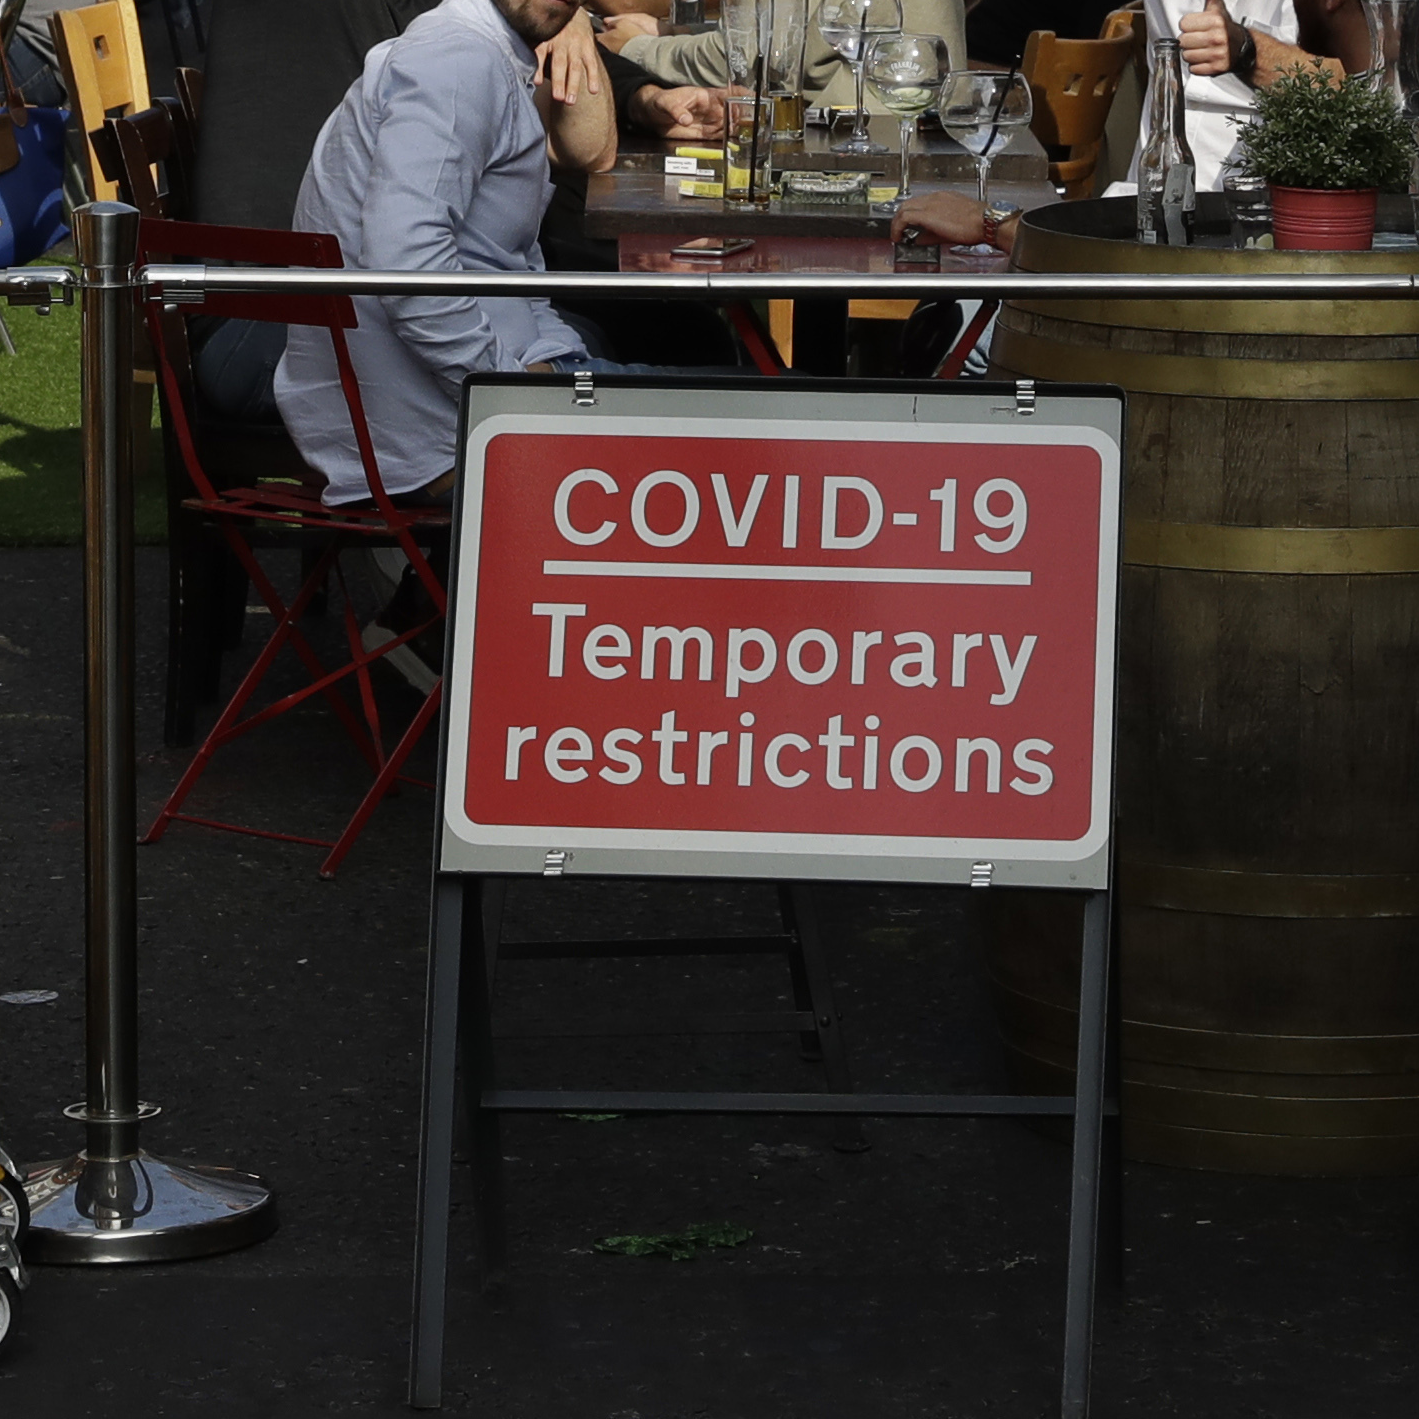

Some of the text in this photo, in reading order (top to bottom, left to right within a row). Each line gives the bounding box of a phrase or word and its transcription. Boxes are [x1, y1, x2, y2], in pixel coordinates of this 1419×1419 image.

[552, 468, 1029, 554] COVID-19
[531, 602, 1038, 706] Temporary
[504, 709, 1055, 797] restrictions
